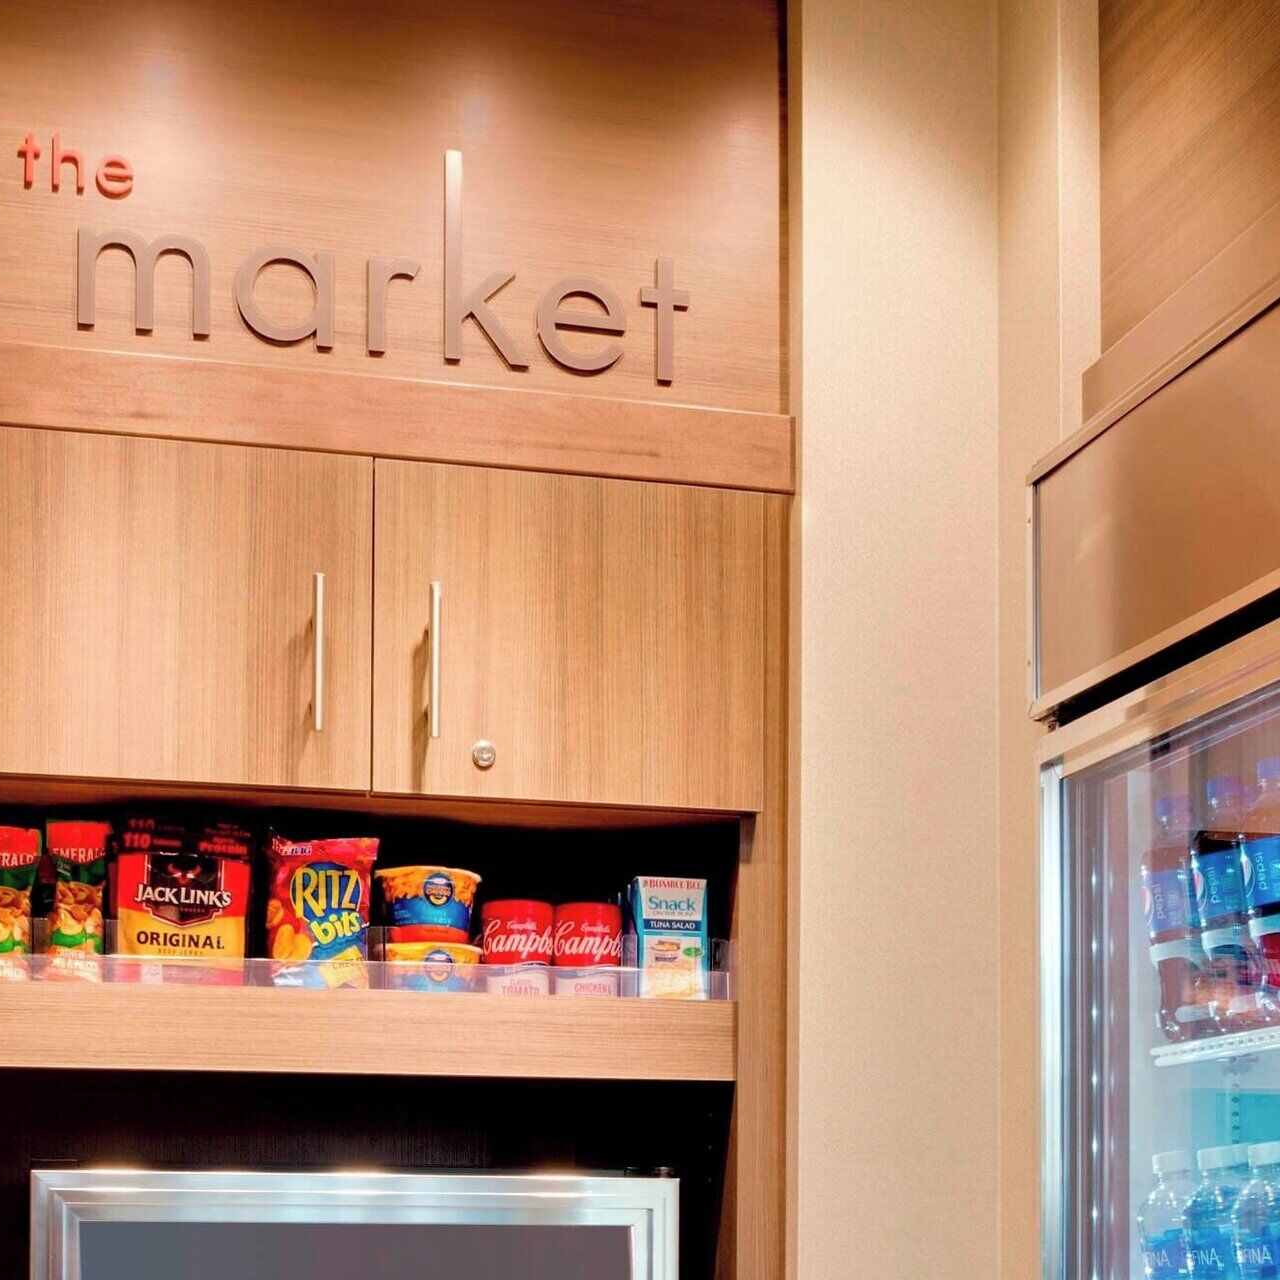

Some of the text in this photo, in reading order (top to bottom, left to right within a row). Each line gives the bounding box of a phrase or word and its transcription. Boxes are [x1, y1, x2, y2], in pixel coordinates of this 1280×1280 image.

[19, 132, 134, 197] the
[75, 149, 689, 386] market
[123, 832, 151, 848] 110
[1255, 851, 1270, 892] pepsi
[134, 884, 232, 908] JACK LINK'S
[294, 867, 359, 919] RITZ
[648, 896, 696, 912] Snack
[310, 911, 362, 945] bits
[671, 921, 696, 930] SALAD
[136, 931, 225, 950] ORIGINAL
